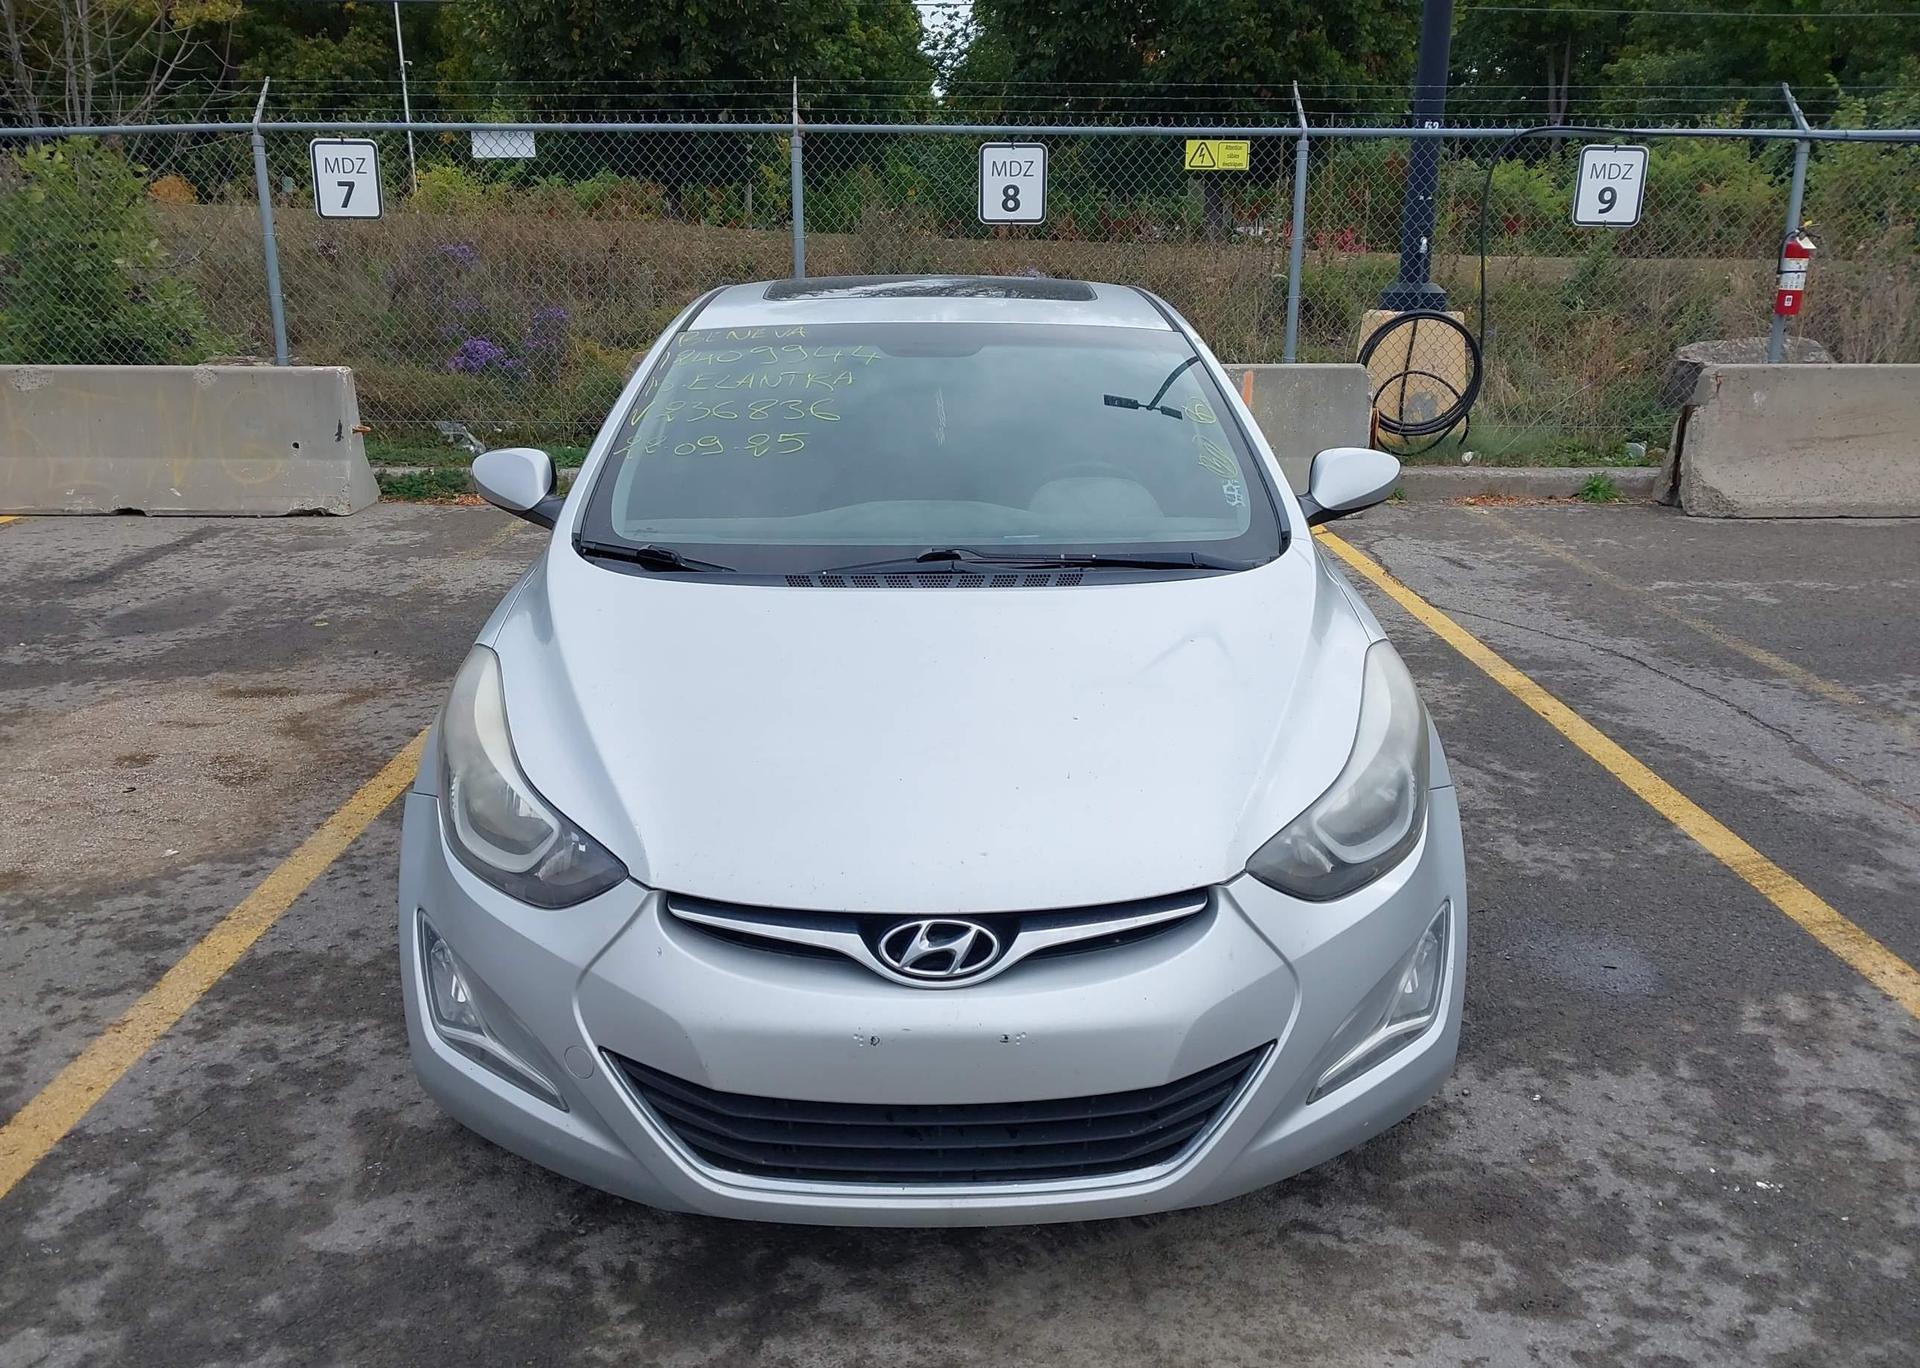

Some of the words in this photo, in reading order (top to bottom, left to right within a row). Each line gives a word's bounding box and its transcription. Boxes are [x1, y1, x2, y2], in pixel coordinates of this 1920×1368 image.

[324, 156, 368, 174] MDZ
[991, 160, 1035, 177] MDZ
[1589, 162, 1635, 180] MDZ
[336, 180, 356, 209] 7
[1001, 184, 1021, 213] 8
[1597, 186, 1618, 214] 9
